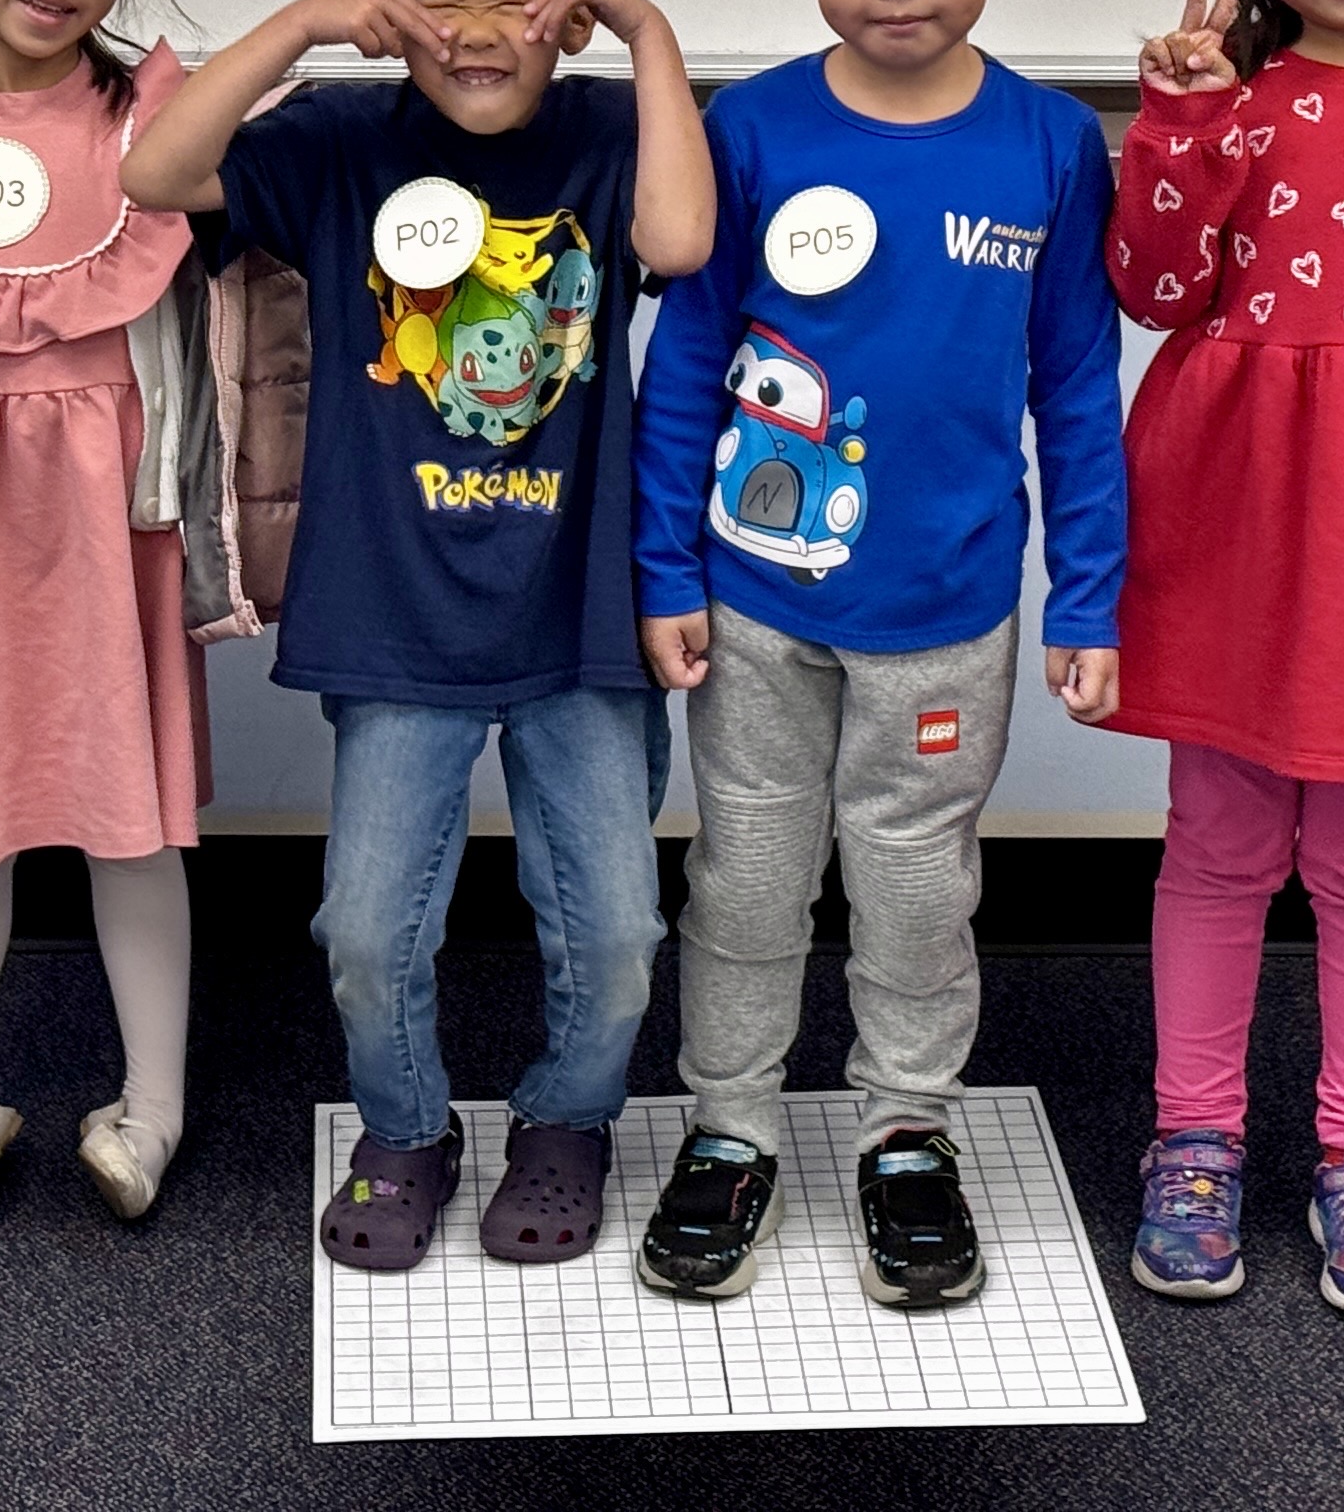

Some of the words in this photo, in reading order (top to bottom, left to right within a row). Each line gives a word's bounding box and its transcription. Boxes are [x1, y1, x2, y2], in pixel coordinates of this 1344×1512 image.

[396, 217, 460, 251] P02
[789, 224, 854, 259] P05
[921, 723, 957, 740] LEGO
